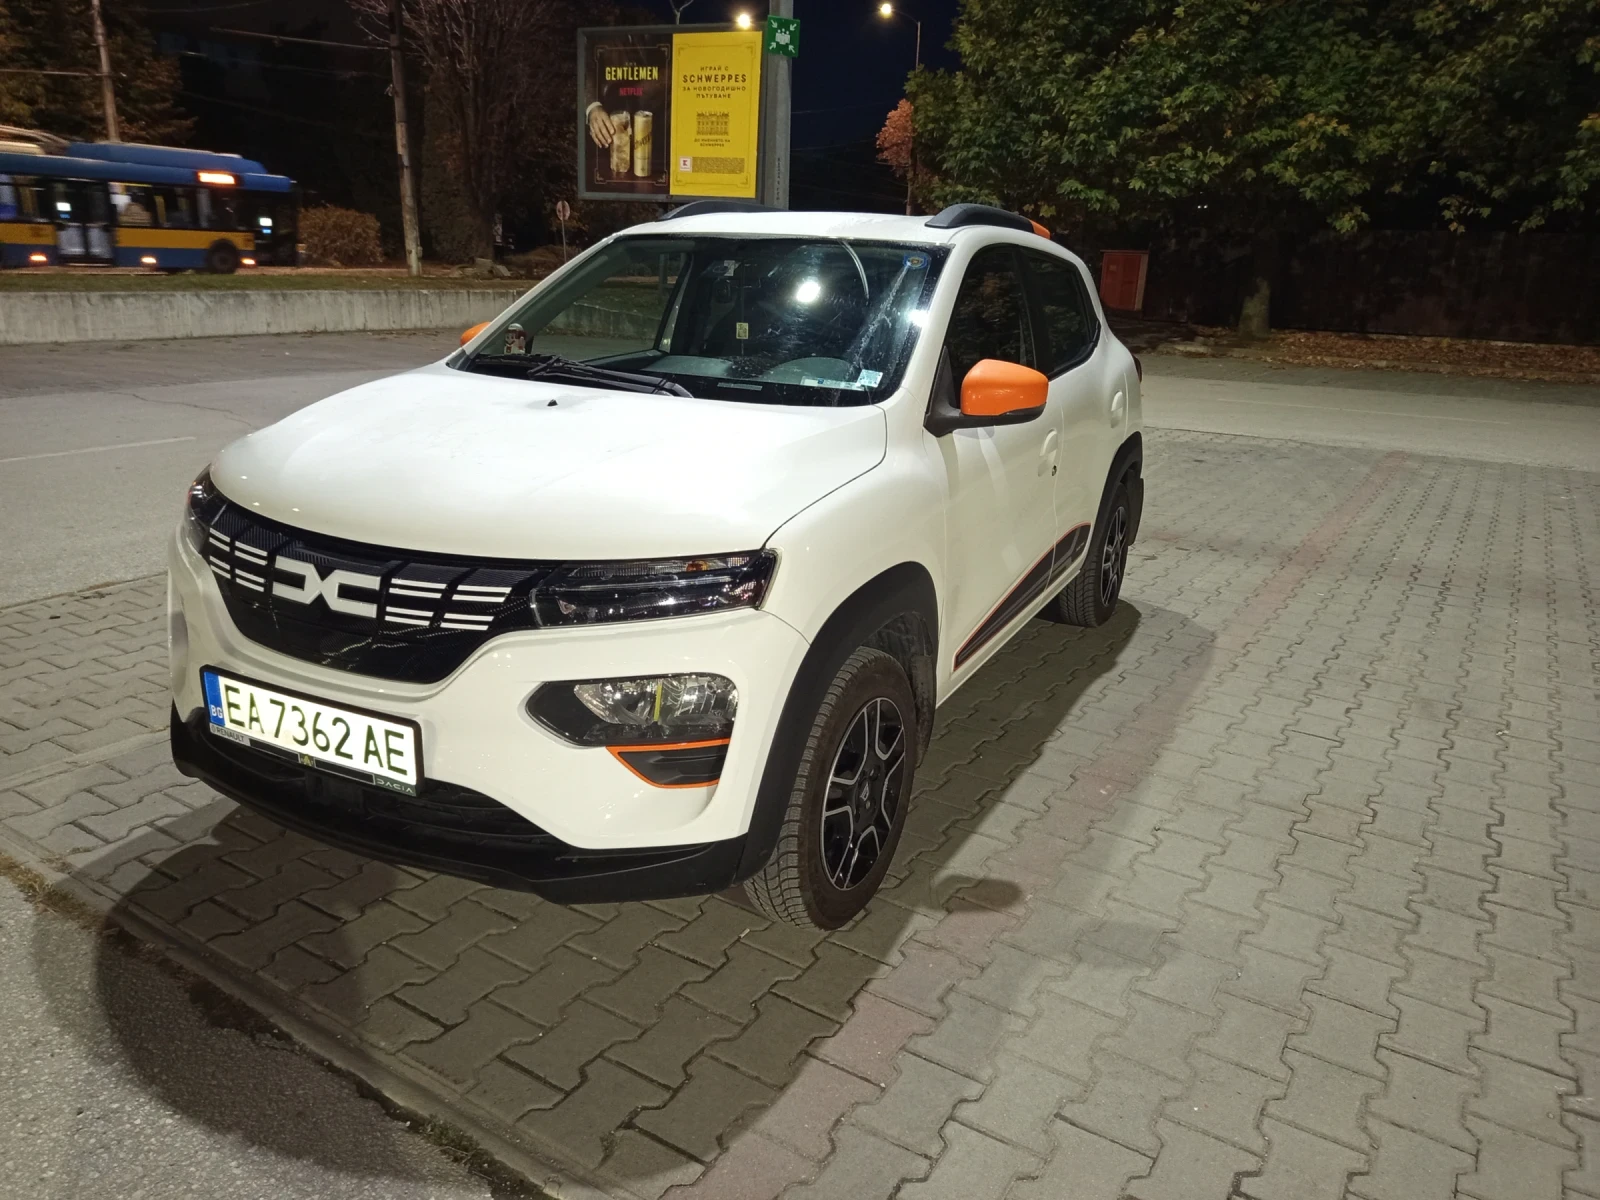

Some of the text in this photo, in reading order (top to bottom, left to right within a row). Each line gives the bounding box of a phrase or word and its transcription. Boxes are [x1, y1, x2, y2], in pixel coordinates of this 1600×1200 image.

[605, 66, 659, 81] GENTLEMEN
[682, 74, 747, 83] SCHWEPPES
[210, 704, 224, 719] BG
[216, 726, 245, 743] RENAULT
[269, 698, 354, 760] 7362
[363, 724, 408, 776] AE
[376, 778, 413, 794] DACIA
